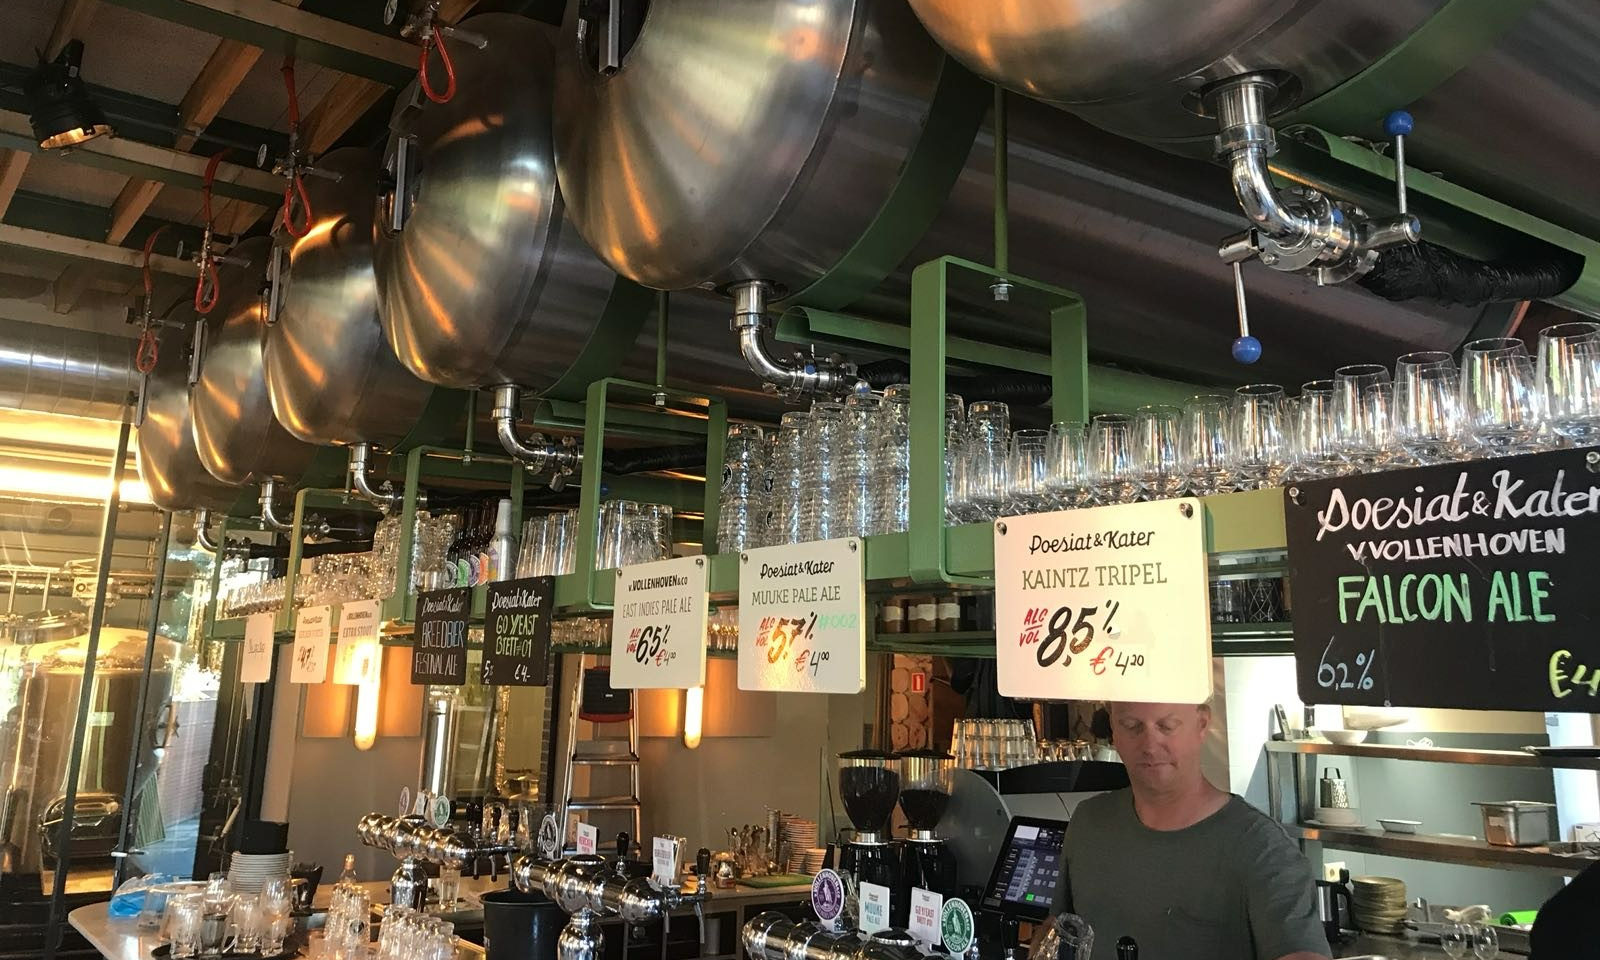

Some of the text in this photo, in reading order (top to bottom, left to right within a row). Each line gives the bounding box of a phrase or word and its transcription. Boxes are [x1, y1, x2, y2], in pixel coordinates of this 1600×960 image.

[1029, 530, 1155, 555] Poesiat&Kater
[760, 560, 835, 579] Poesiat&Kater
[1022, 562, 1168, 590] KAINTZ TRIPEL
[752, 585, 841, 606] MUUKE PALE ALE
[1338, 571, 1556, 624] FALCON ALE
[622, 596, 692, 619] EAST INDIES PALE ALE
[1024, 607, 1048, 626] ALC
[421, 620, 465, 649] BREEDBIER
[495, 614, 509, 635] GO
[760, 616, 776, 631] ALC
[1019, 630, 1040, 647] VOL
[444, 654, 458, 676] ALE
[1317, 636, 1375, 690] 6,2%
